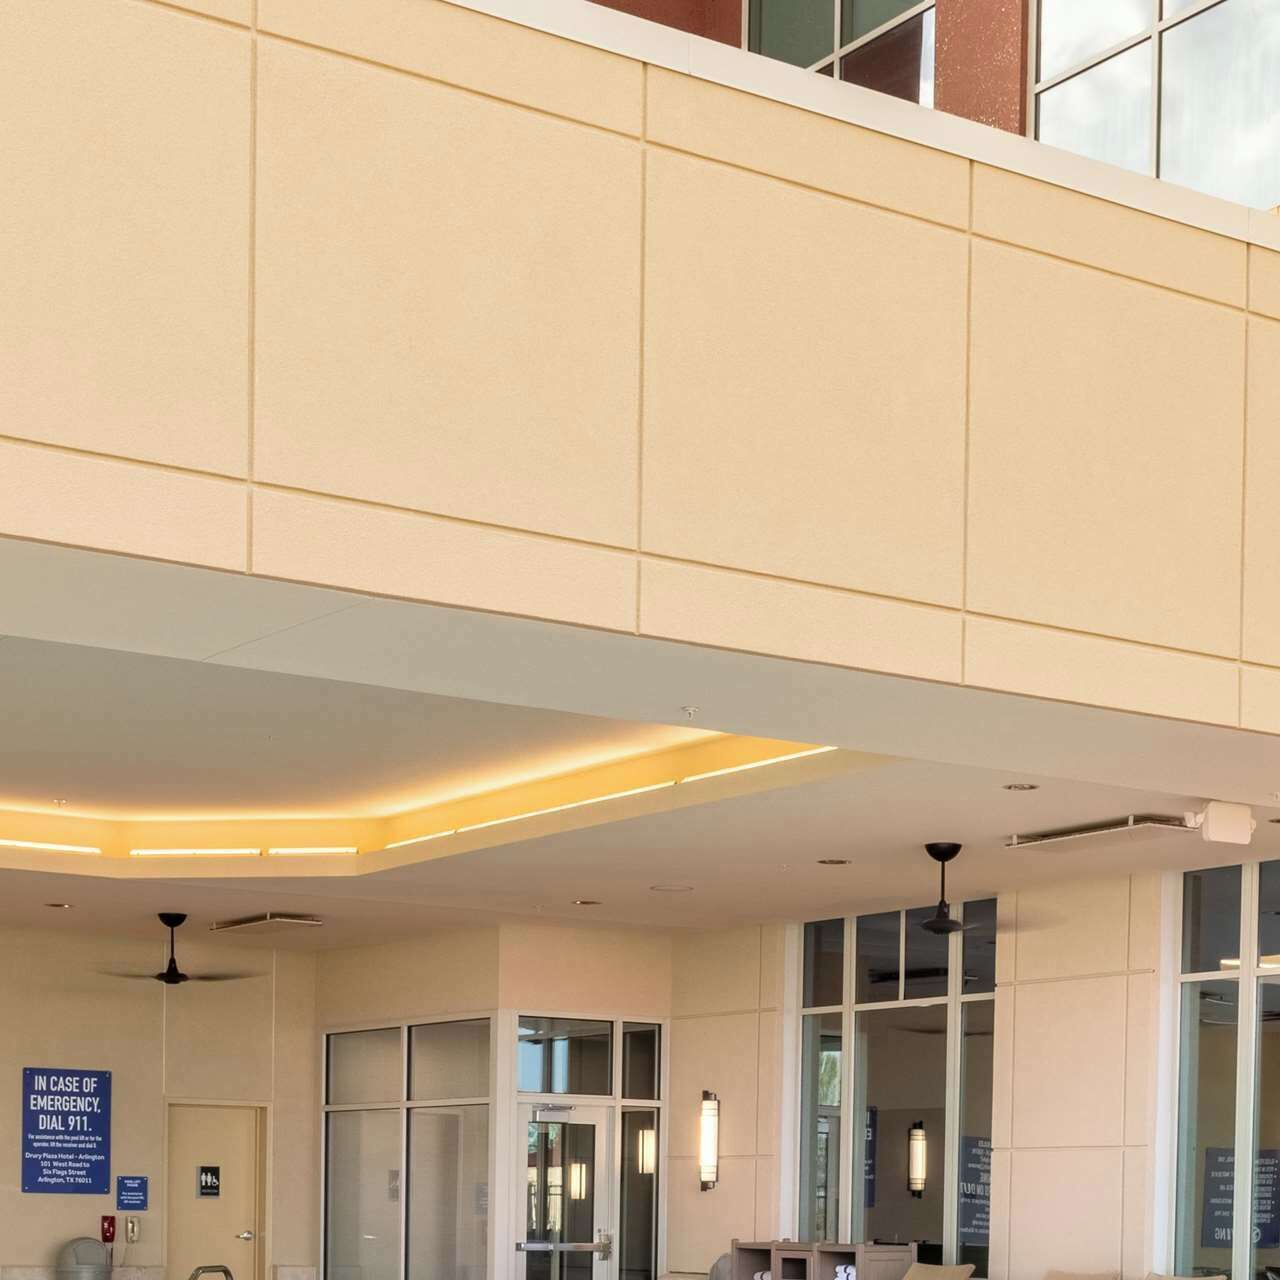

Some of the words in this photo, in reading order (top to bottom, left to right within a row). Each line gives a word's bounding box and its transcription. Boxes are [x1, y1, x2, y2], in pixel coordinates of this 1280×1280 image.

[35, 1076, 46, 1091] IN
[50, 1076, 80, 1092] CASE
[83, 1077, 98, 1093] OF
[39, 1115, 65, 1131] DIAL
[68, 1116, 92, 1131] 911.
